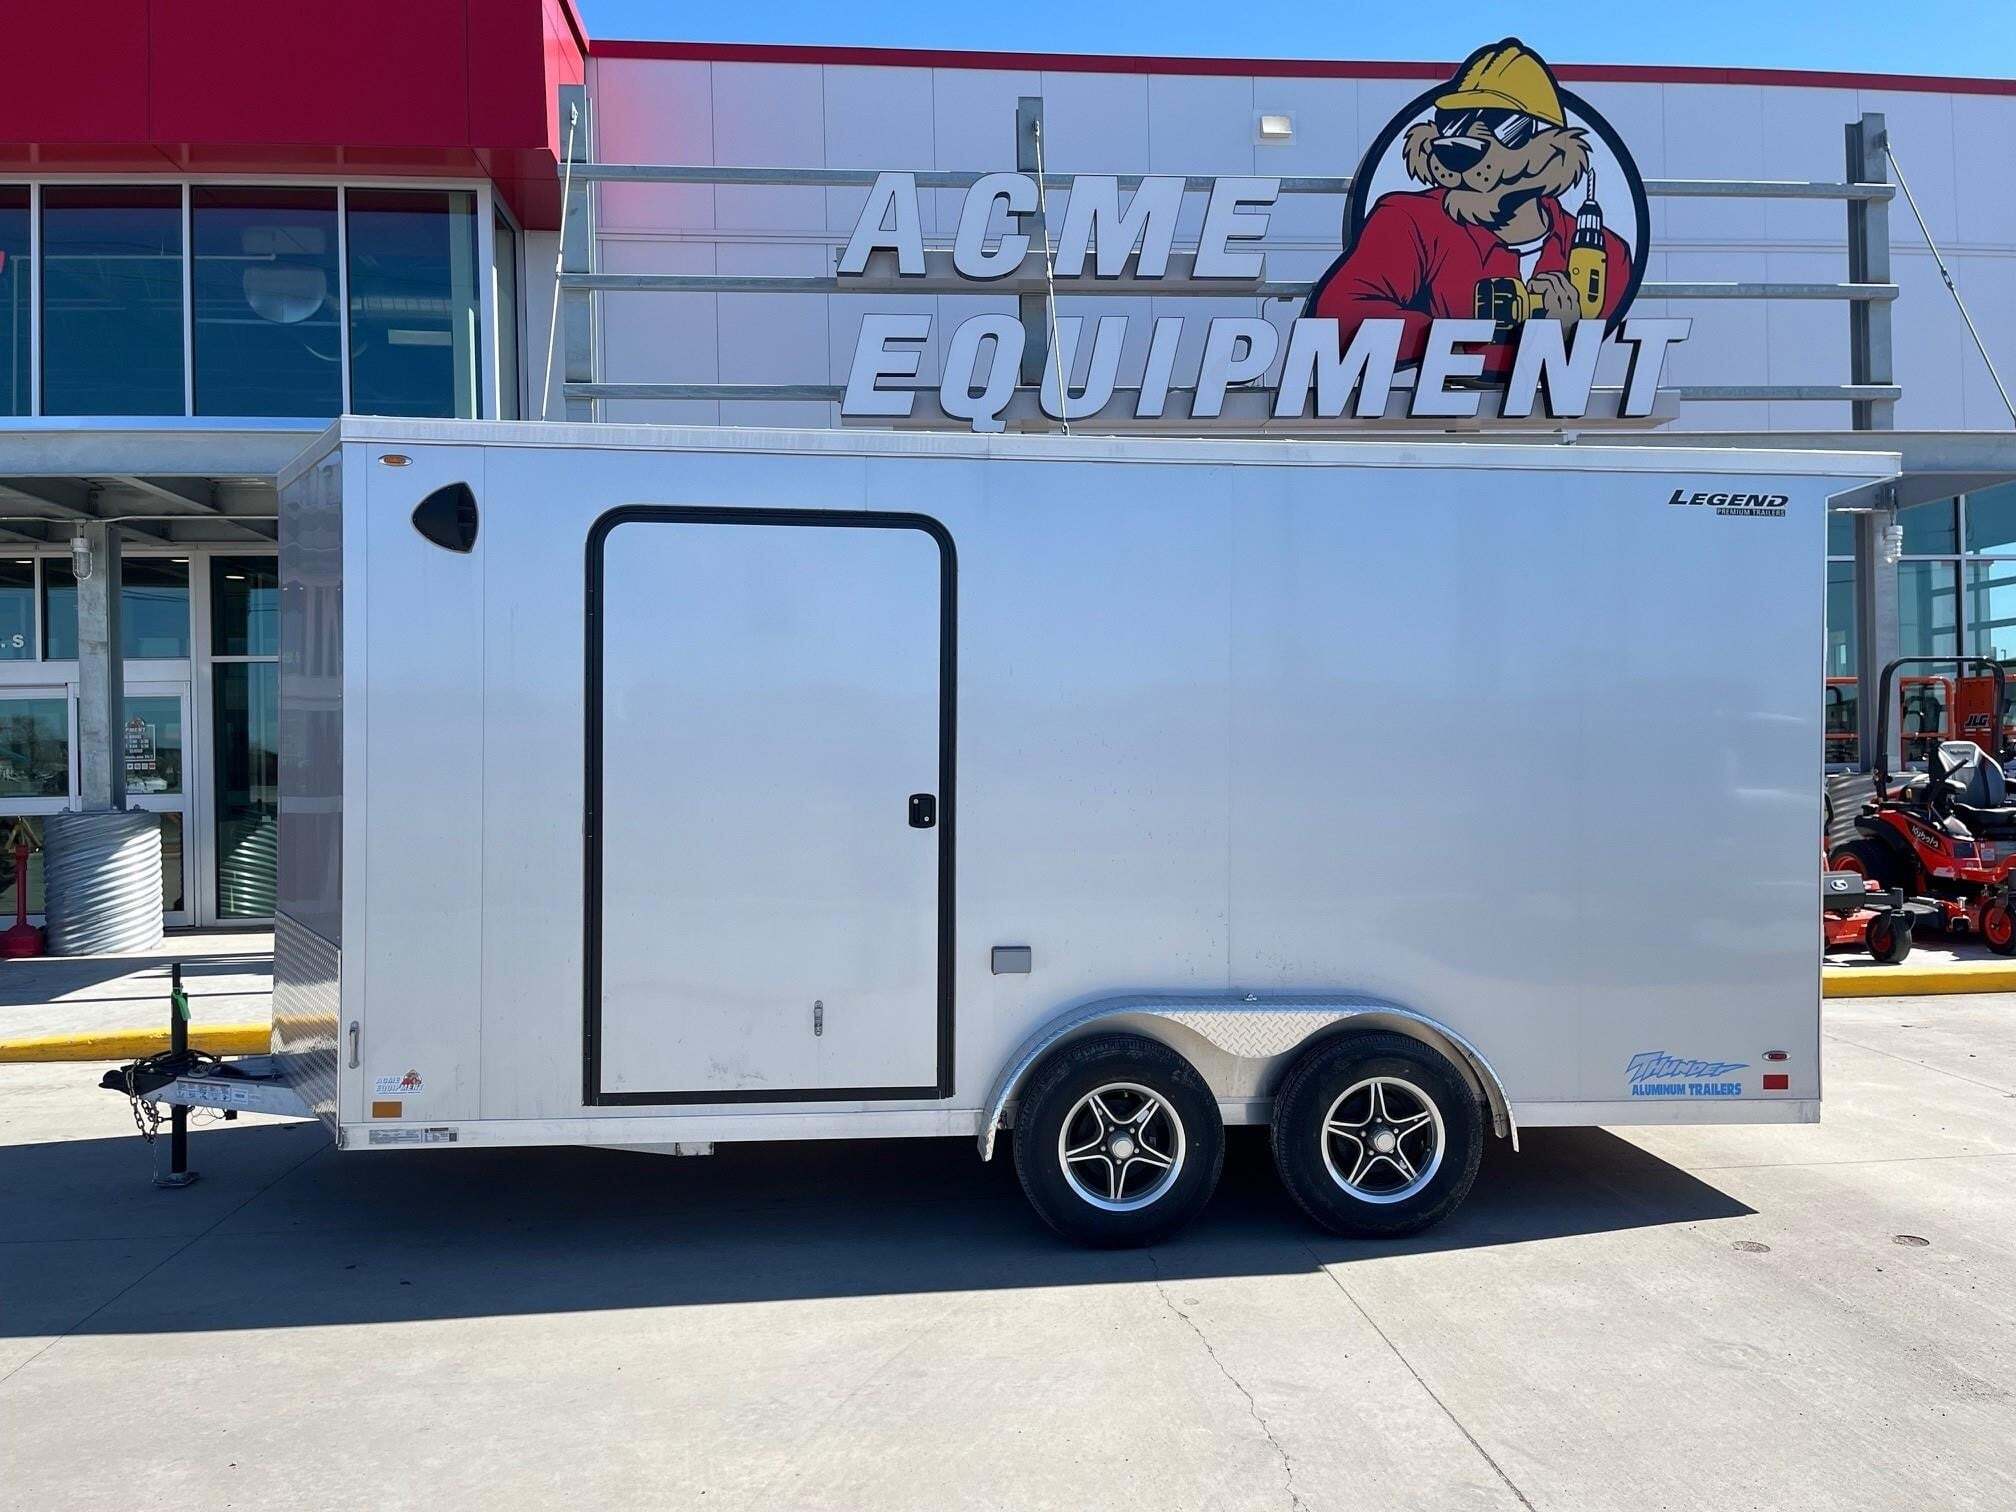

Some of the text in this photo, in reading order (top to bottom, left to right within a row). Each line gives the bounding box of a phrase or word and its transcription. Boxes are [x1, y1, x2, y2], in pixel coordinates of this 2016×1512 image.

[837, 171, 1281, 281] ACME
[841, 313, 1693, 433] EQUIPMENT
[1668, 489, 1789, 507] LEGEND
[1717, 507, 1785, 517] PREMIUM TRAILERS
[1964, 714, 1990, 728] JLG
[1911, 825, 1939, 848] Kubota
[1631, 1083, 1742, 1096] ALUMINUM TRAILERS
